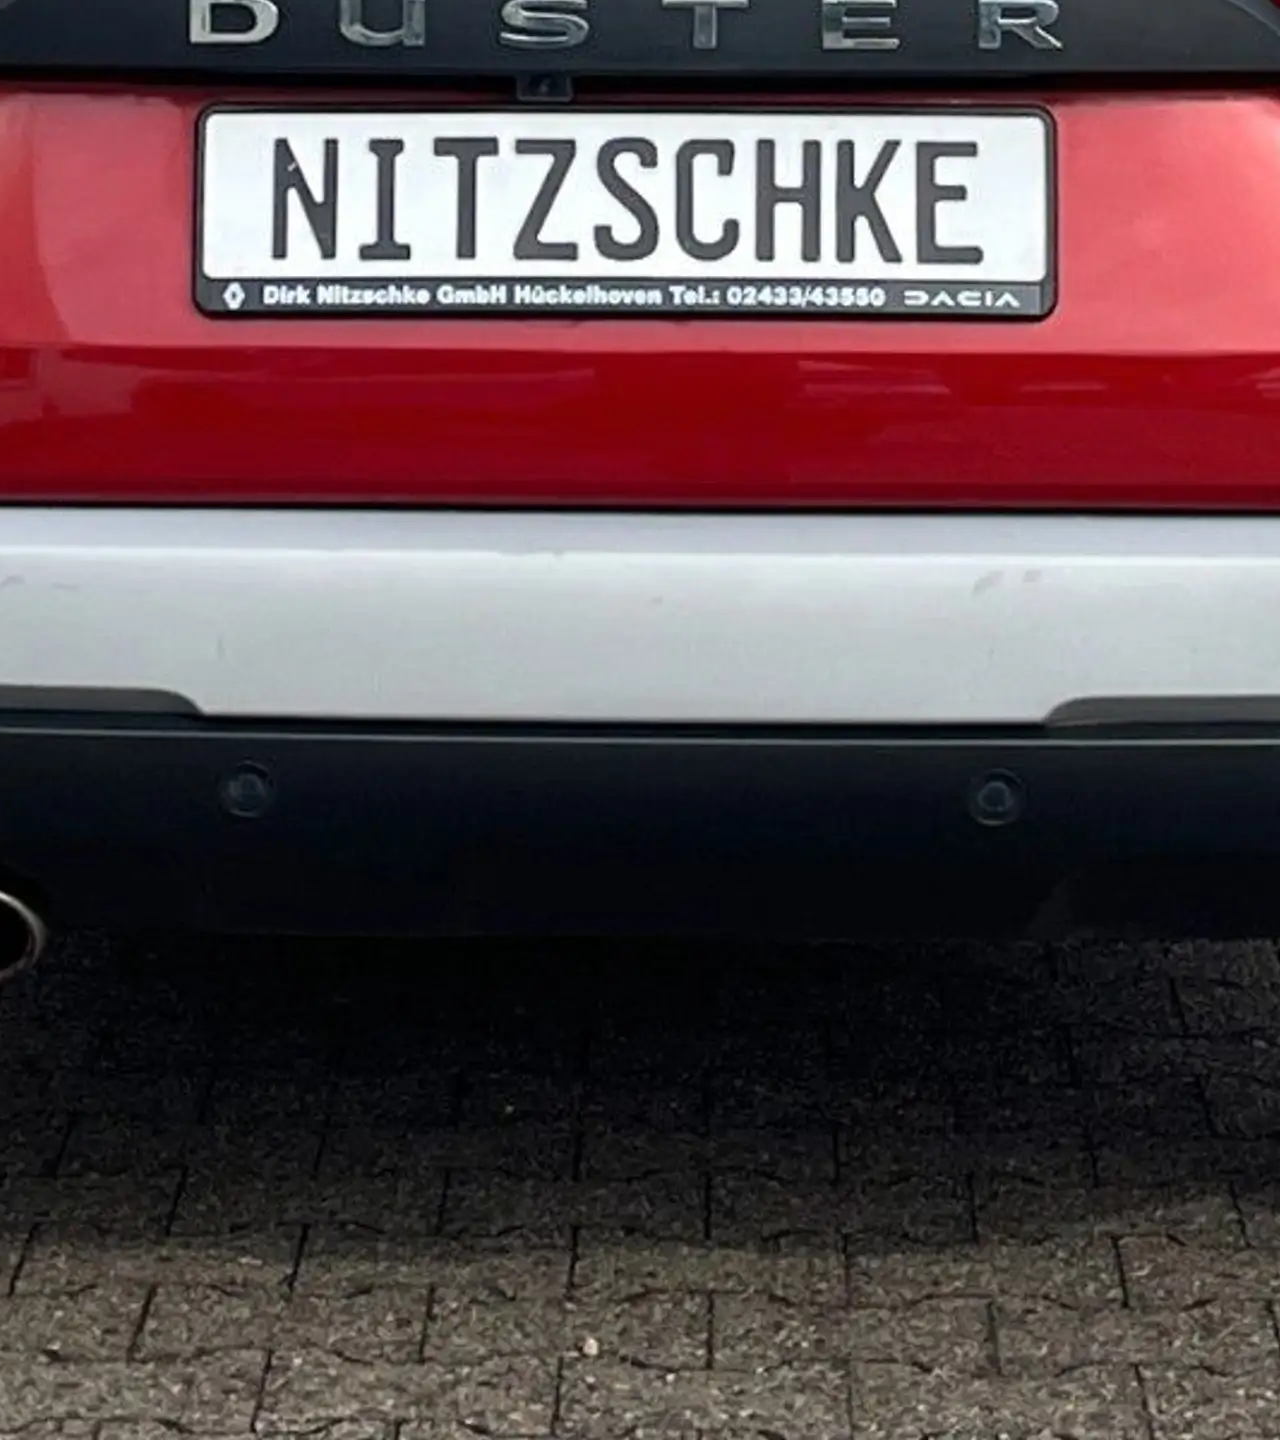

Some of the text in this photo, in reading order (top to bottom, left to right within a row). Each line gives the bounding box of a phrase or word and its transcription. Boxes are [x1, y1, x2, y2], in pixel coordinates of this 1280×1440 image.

[272, 138, 985, 264] NITZSCHKE
[263, 284, 310, 305] Dirk
[317, 284, 430, 305] Nitzschke
[437, 285, 507, 305] GmbH
[514, 284, 661, 306] Hückelhoven
[669, 286, 720, 306] Tel.:
[904, 290, 1019, 307] DACIA
